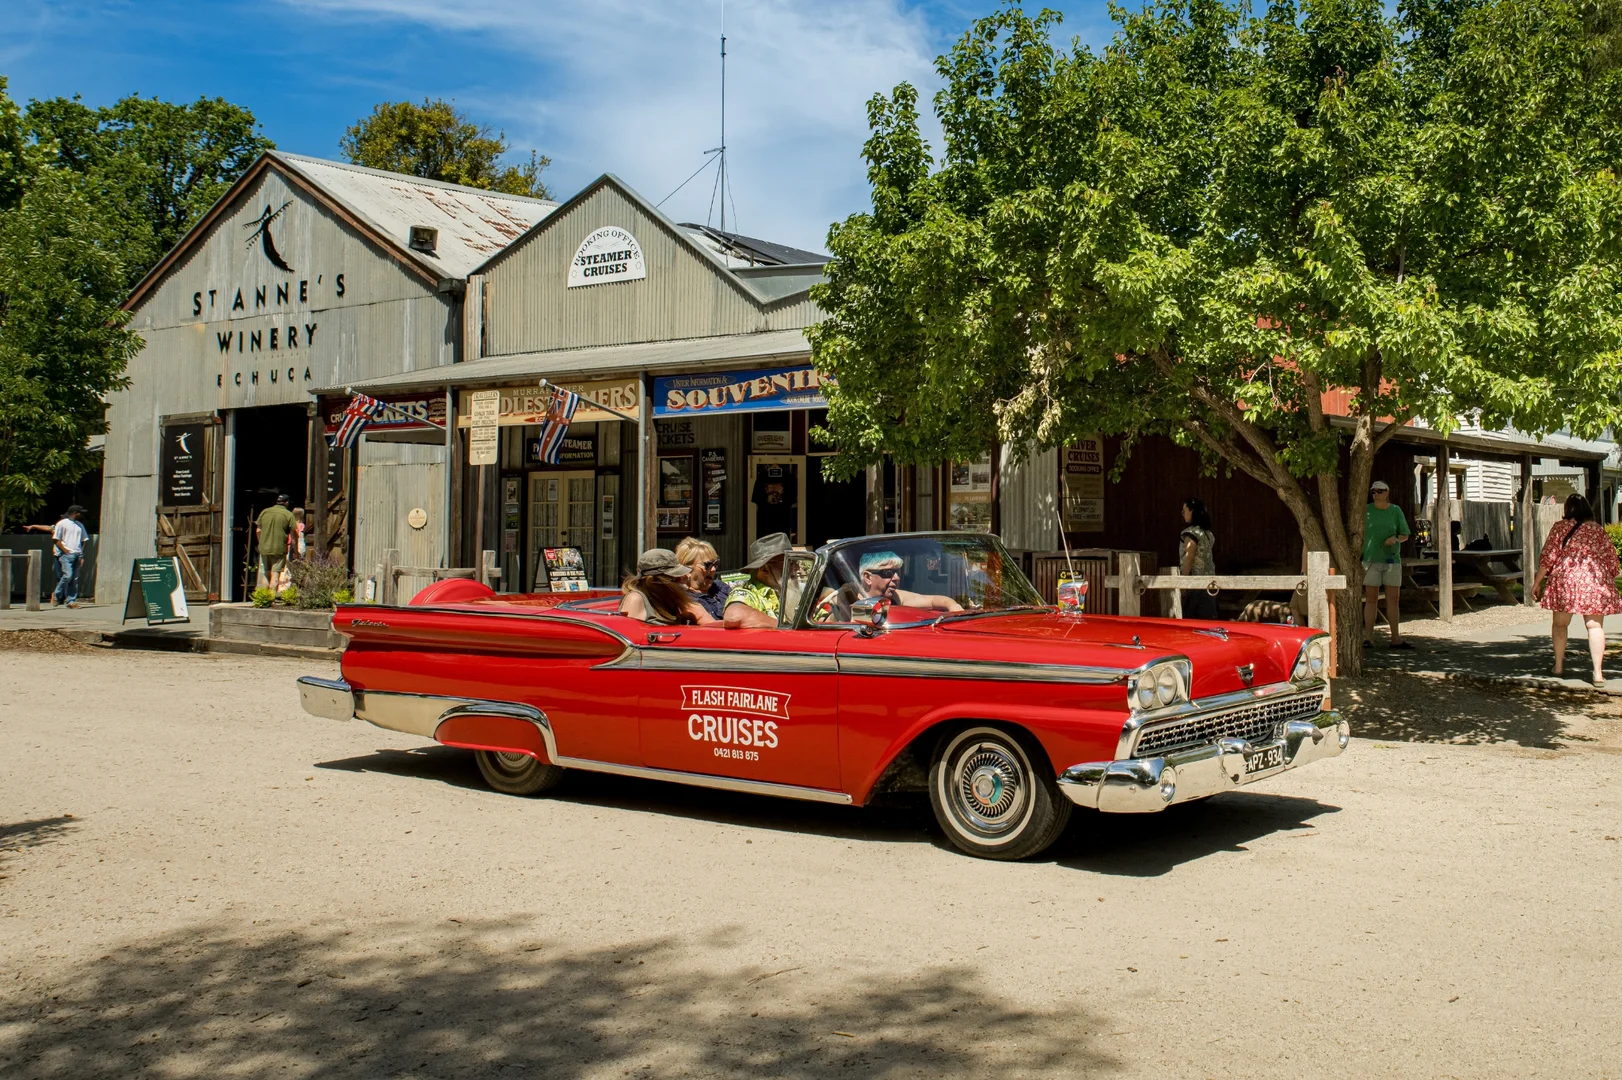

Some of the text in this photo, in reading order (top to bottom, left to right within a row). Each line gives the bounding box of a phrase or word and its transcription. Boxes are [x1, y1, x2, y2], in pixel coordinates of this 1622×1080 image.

[574, 230, 640, 266] BOOKING OFFICE
[580, 250, 632, 266] STEAMER
[583, 263, 628, 278] CRUISES
[232, 273, 346, 311] ANNE'S
[217, 323, 318, 354] WINERY
[217, 366, 312, 387] ECHUCA
[672, 379, 690, 388] VISITOR
[690, 376, 721, 387] INFORMATION
[667, 369, 838, 409] SOUVENIR
[1068, 451, 1100, 462] CRUISES
[1087, 465, 1100, 473] OFFICE
[692, 690, 778, 712] FLASH FAIRLANE
[688, 714, 779, 748] CRUISES
[714, 747, 759, 761] 0421 813 875
